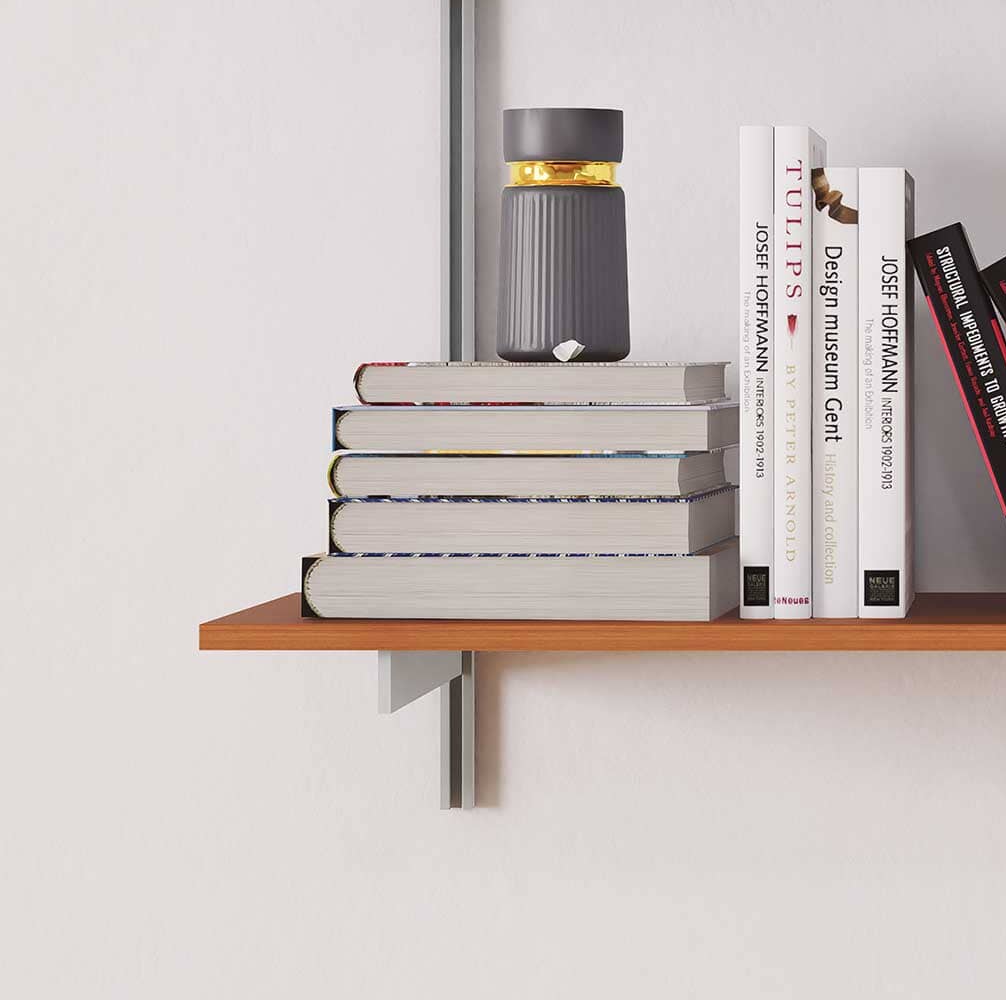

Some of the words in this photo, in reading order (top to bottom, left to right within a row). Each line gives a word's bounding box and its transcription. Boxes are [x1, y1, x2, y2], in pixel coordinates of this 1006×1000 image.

[756, 222, 768, 269] JOSEF
[786, 160, 802, 298] TULIPS
[820, 247, 842, 307] Design
[882, 256, 898, 299] JOSEF
[756, 276, 768, 371] HOFFMANN
[865, 319, 874, 333] The
[937, 247, 968, 309] STRUCTURAL
[960, 311, 993, 376] IMPEDIMENTS
[985, 378, 999, 393] TO
[825, 315, 838, 389] museum
[863, 336, 874, 365] making
[882, 305, 898, 392] HOFFMANN
[786, 364, 796, 389] BY
[756, 378, 764, 427] INTERIORS
[825, 398, 842, 442] Gent
[882, 398, 892, 443] INTERIORS
[756, 431, 764, 478] 1902-1913
[786, 400, 796, 465] PETER
[821, 453, 837, 497] History
[882, 446, 892, 489] 1902-1913
[786, 475, 797, 564] ARNOLD
[824, 499, 837, 523] and
[824, 526, 838, 585] collection
[868, 576, 896, 585] NEUE
